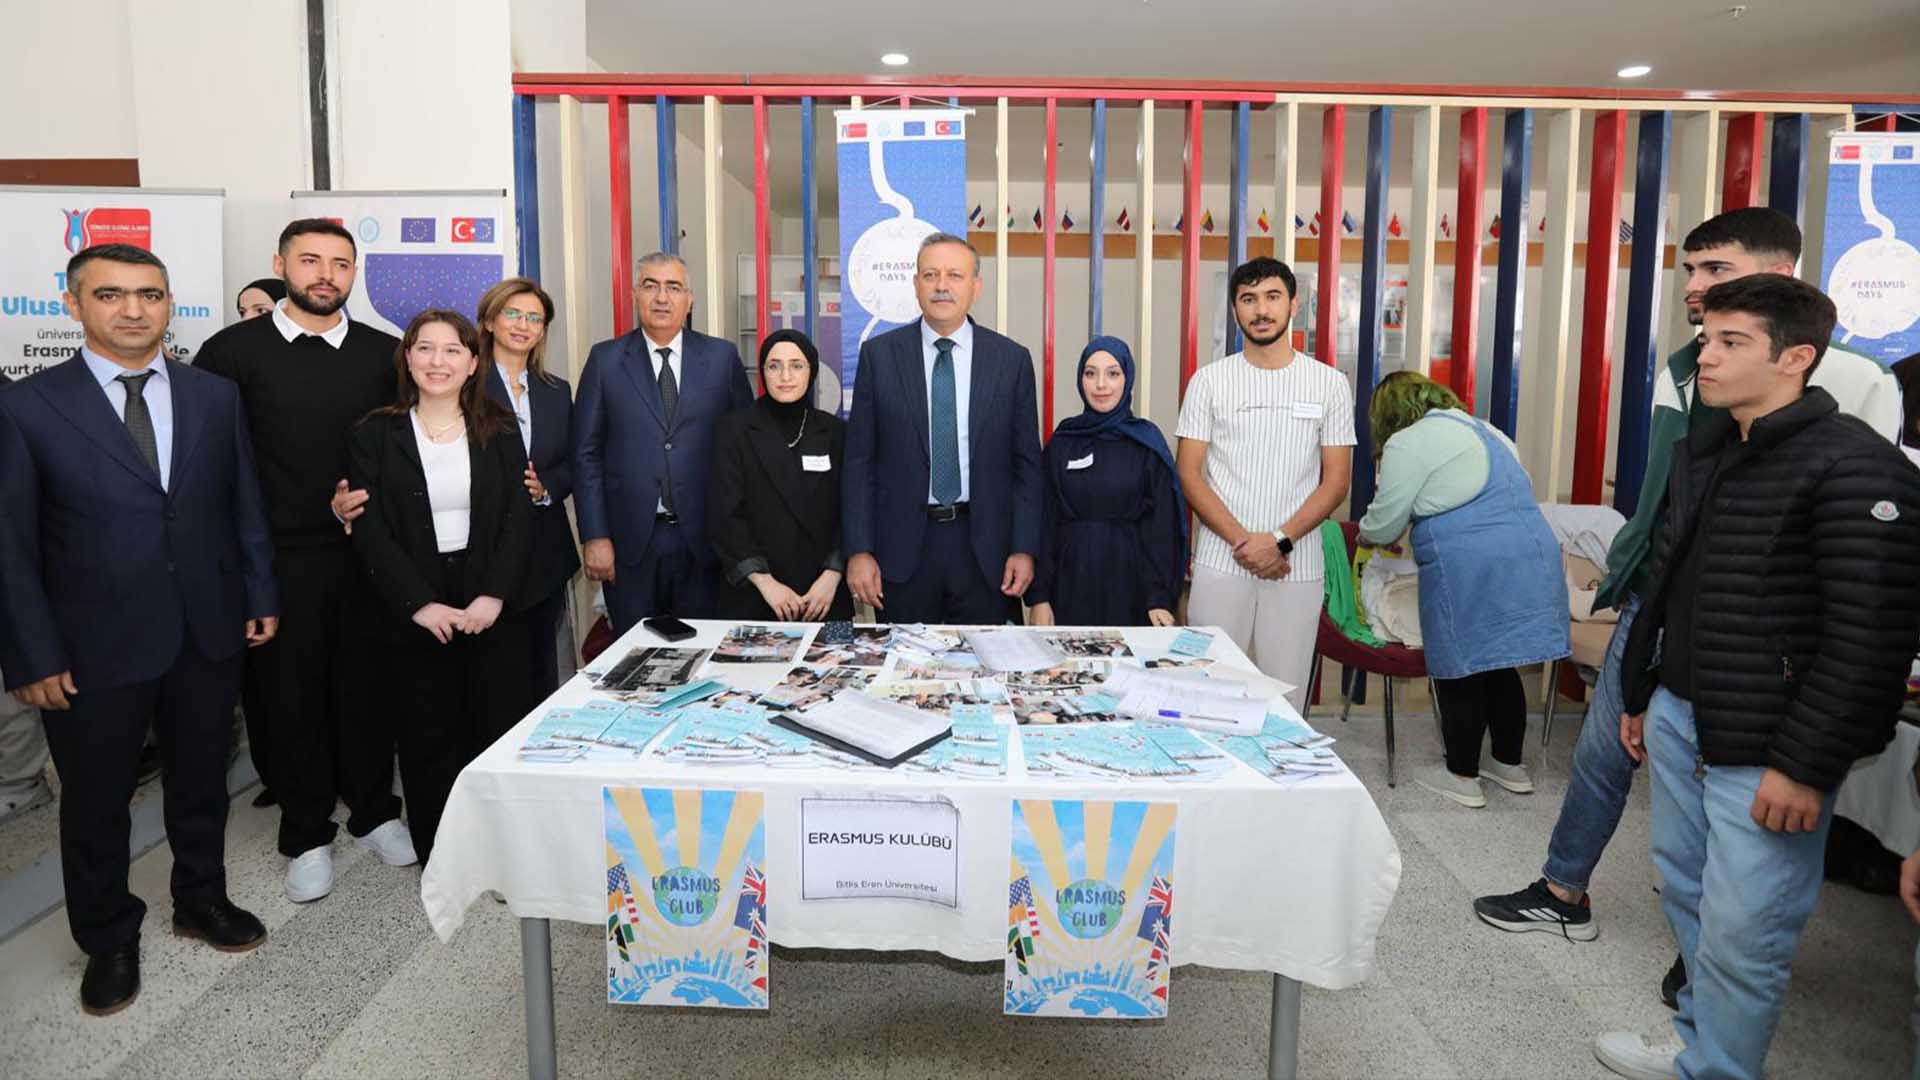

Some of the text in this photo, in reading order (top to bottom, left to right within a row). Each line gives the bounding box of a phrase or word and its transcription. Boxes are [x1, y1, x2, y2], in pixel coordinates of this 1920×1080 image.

[871, 262, 915, 271] #ERASM
[879, 272, 906, 281] DAYS
[1851, 280, 1906, 289] #ERASMUS
[1856, 290, 1884, 298] DAYS
[23, 344, 77, 358] Erasm
[808, 832, 952, 850] ERASMUS KULÜBÜ
[652, 875, 721, 893] ERASMUS
[861, 879, 882, 889] Eren
[1055, 887, 1127, 906] ERASMUS
[670, 898, 704, 915] CLUB
[1072, 911, 1107, 927] CLUB
